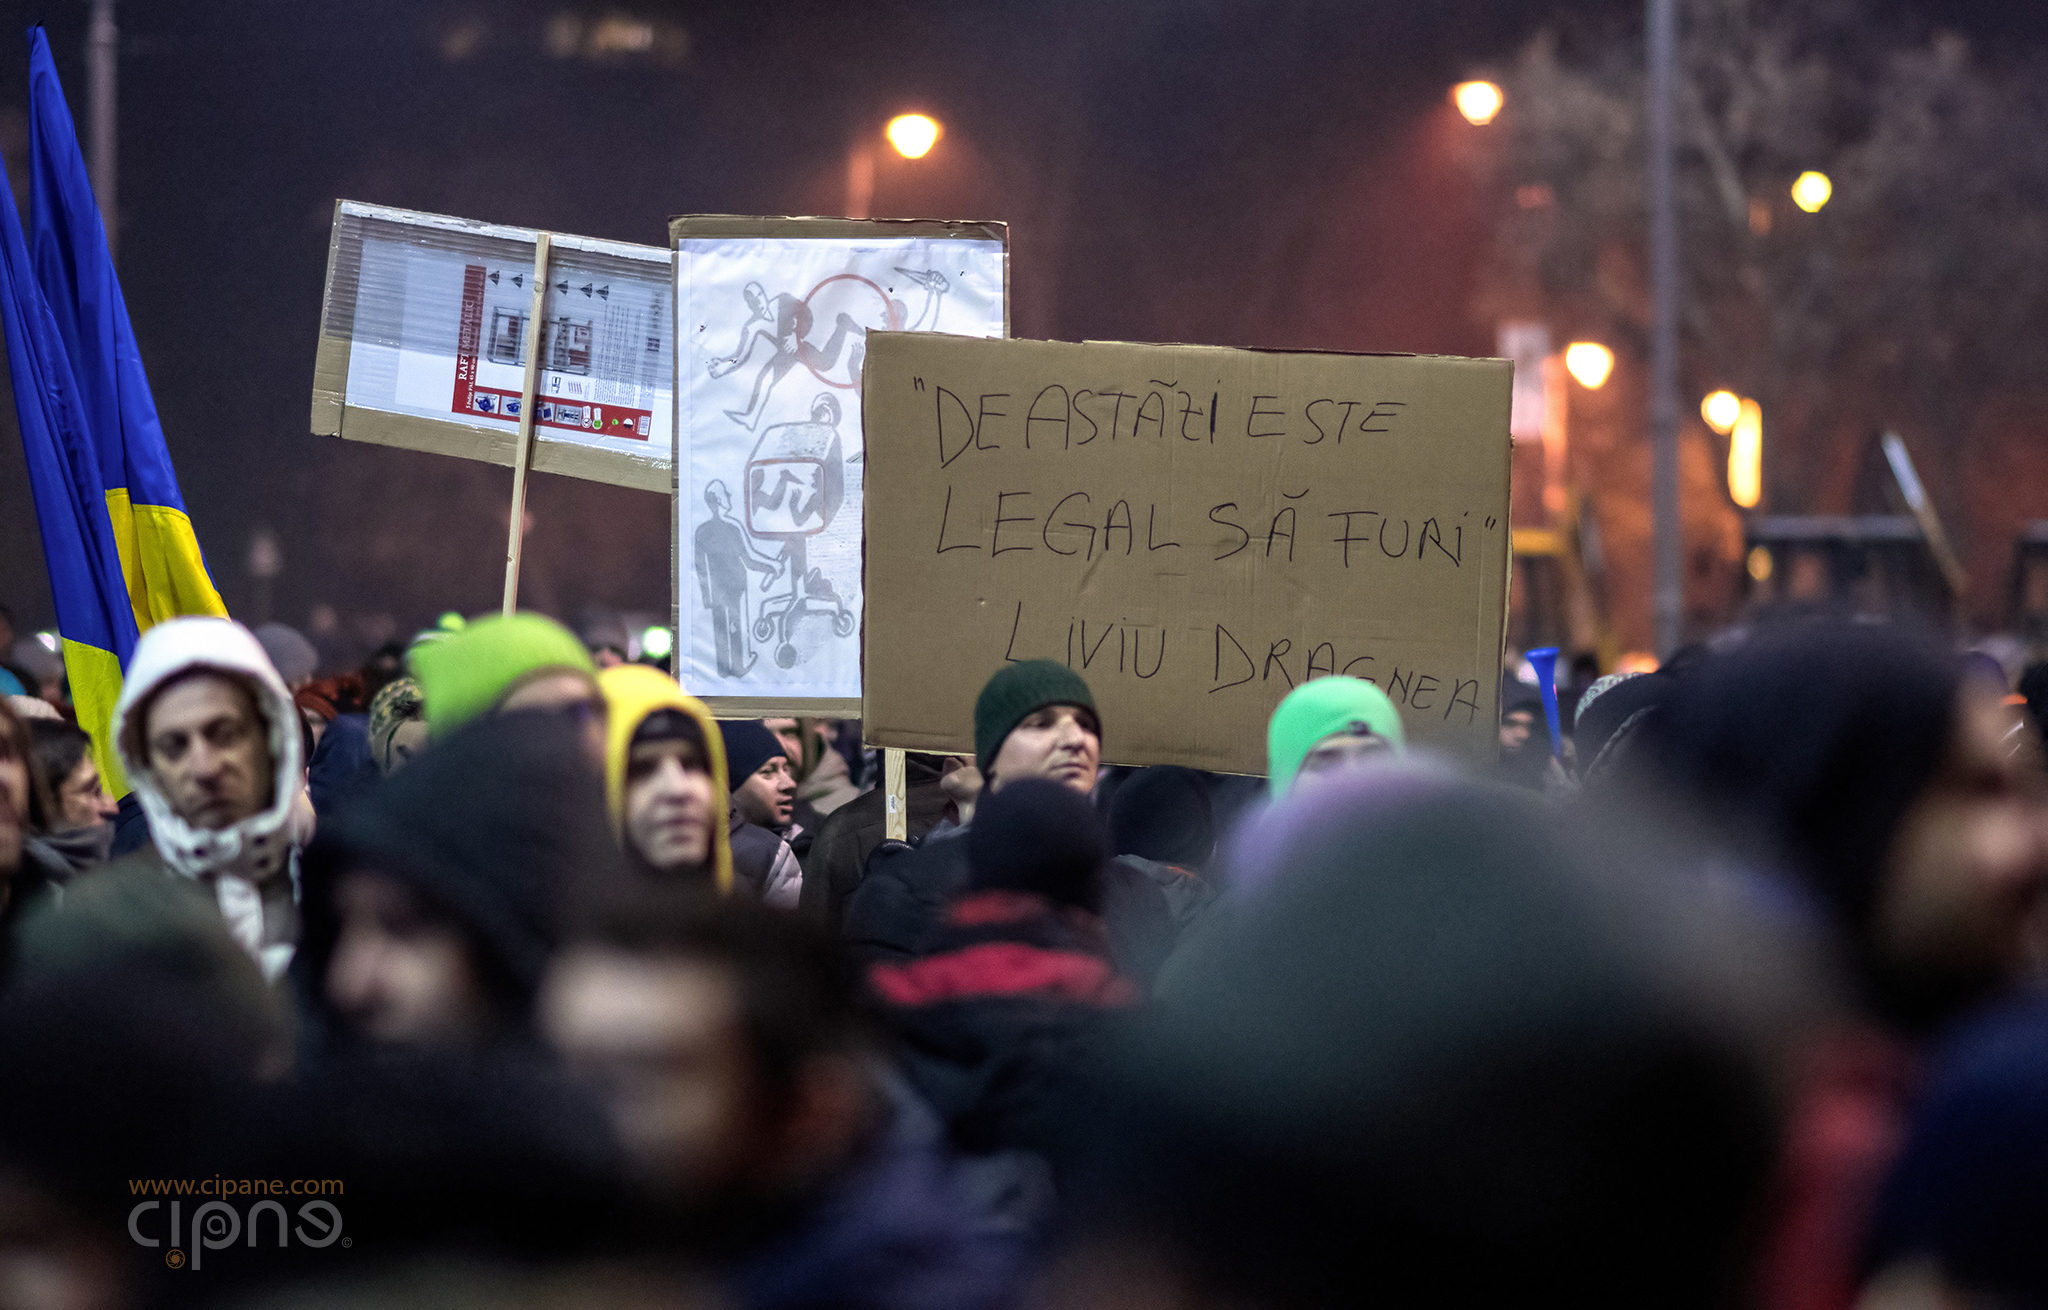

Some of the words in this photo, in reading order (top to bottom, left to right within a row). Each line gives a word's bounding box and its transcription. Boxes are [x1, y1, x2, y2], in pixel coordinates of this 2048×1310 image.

[458, 353, 469, 380] RAFT
[1247, 395, 1407, 445] ESTE
[937, 486, 1181, 561] LEGAL
[1208, 488, 1310, 562] SĂ
